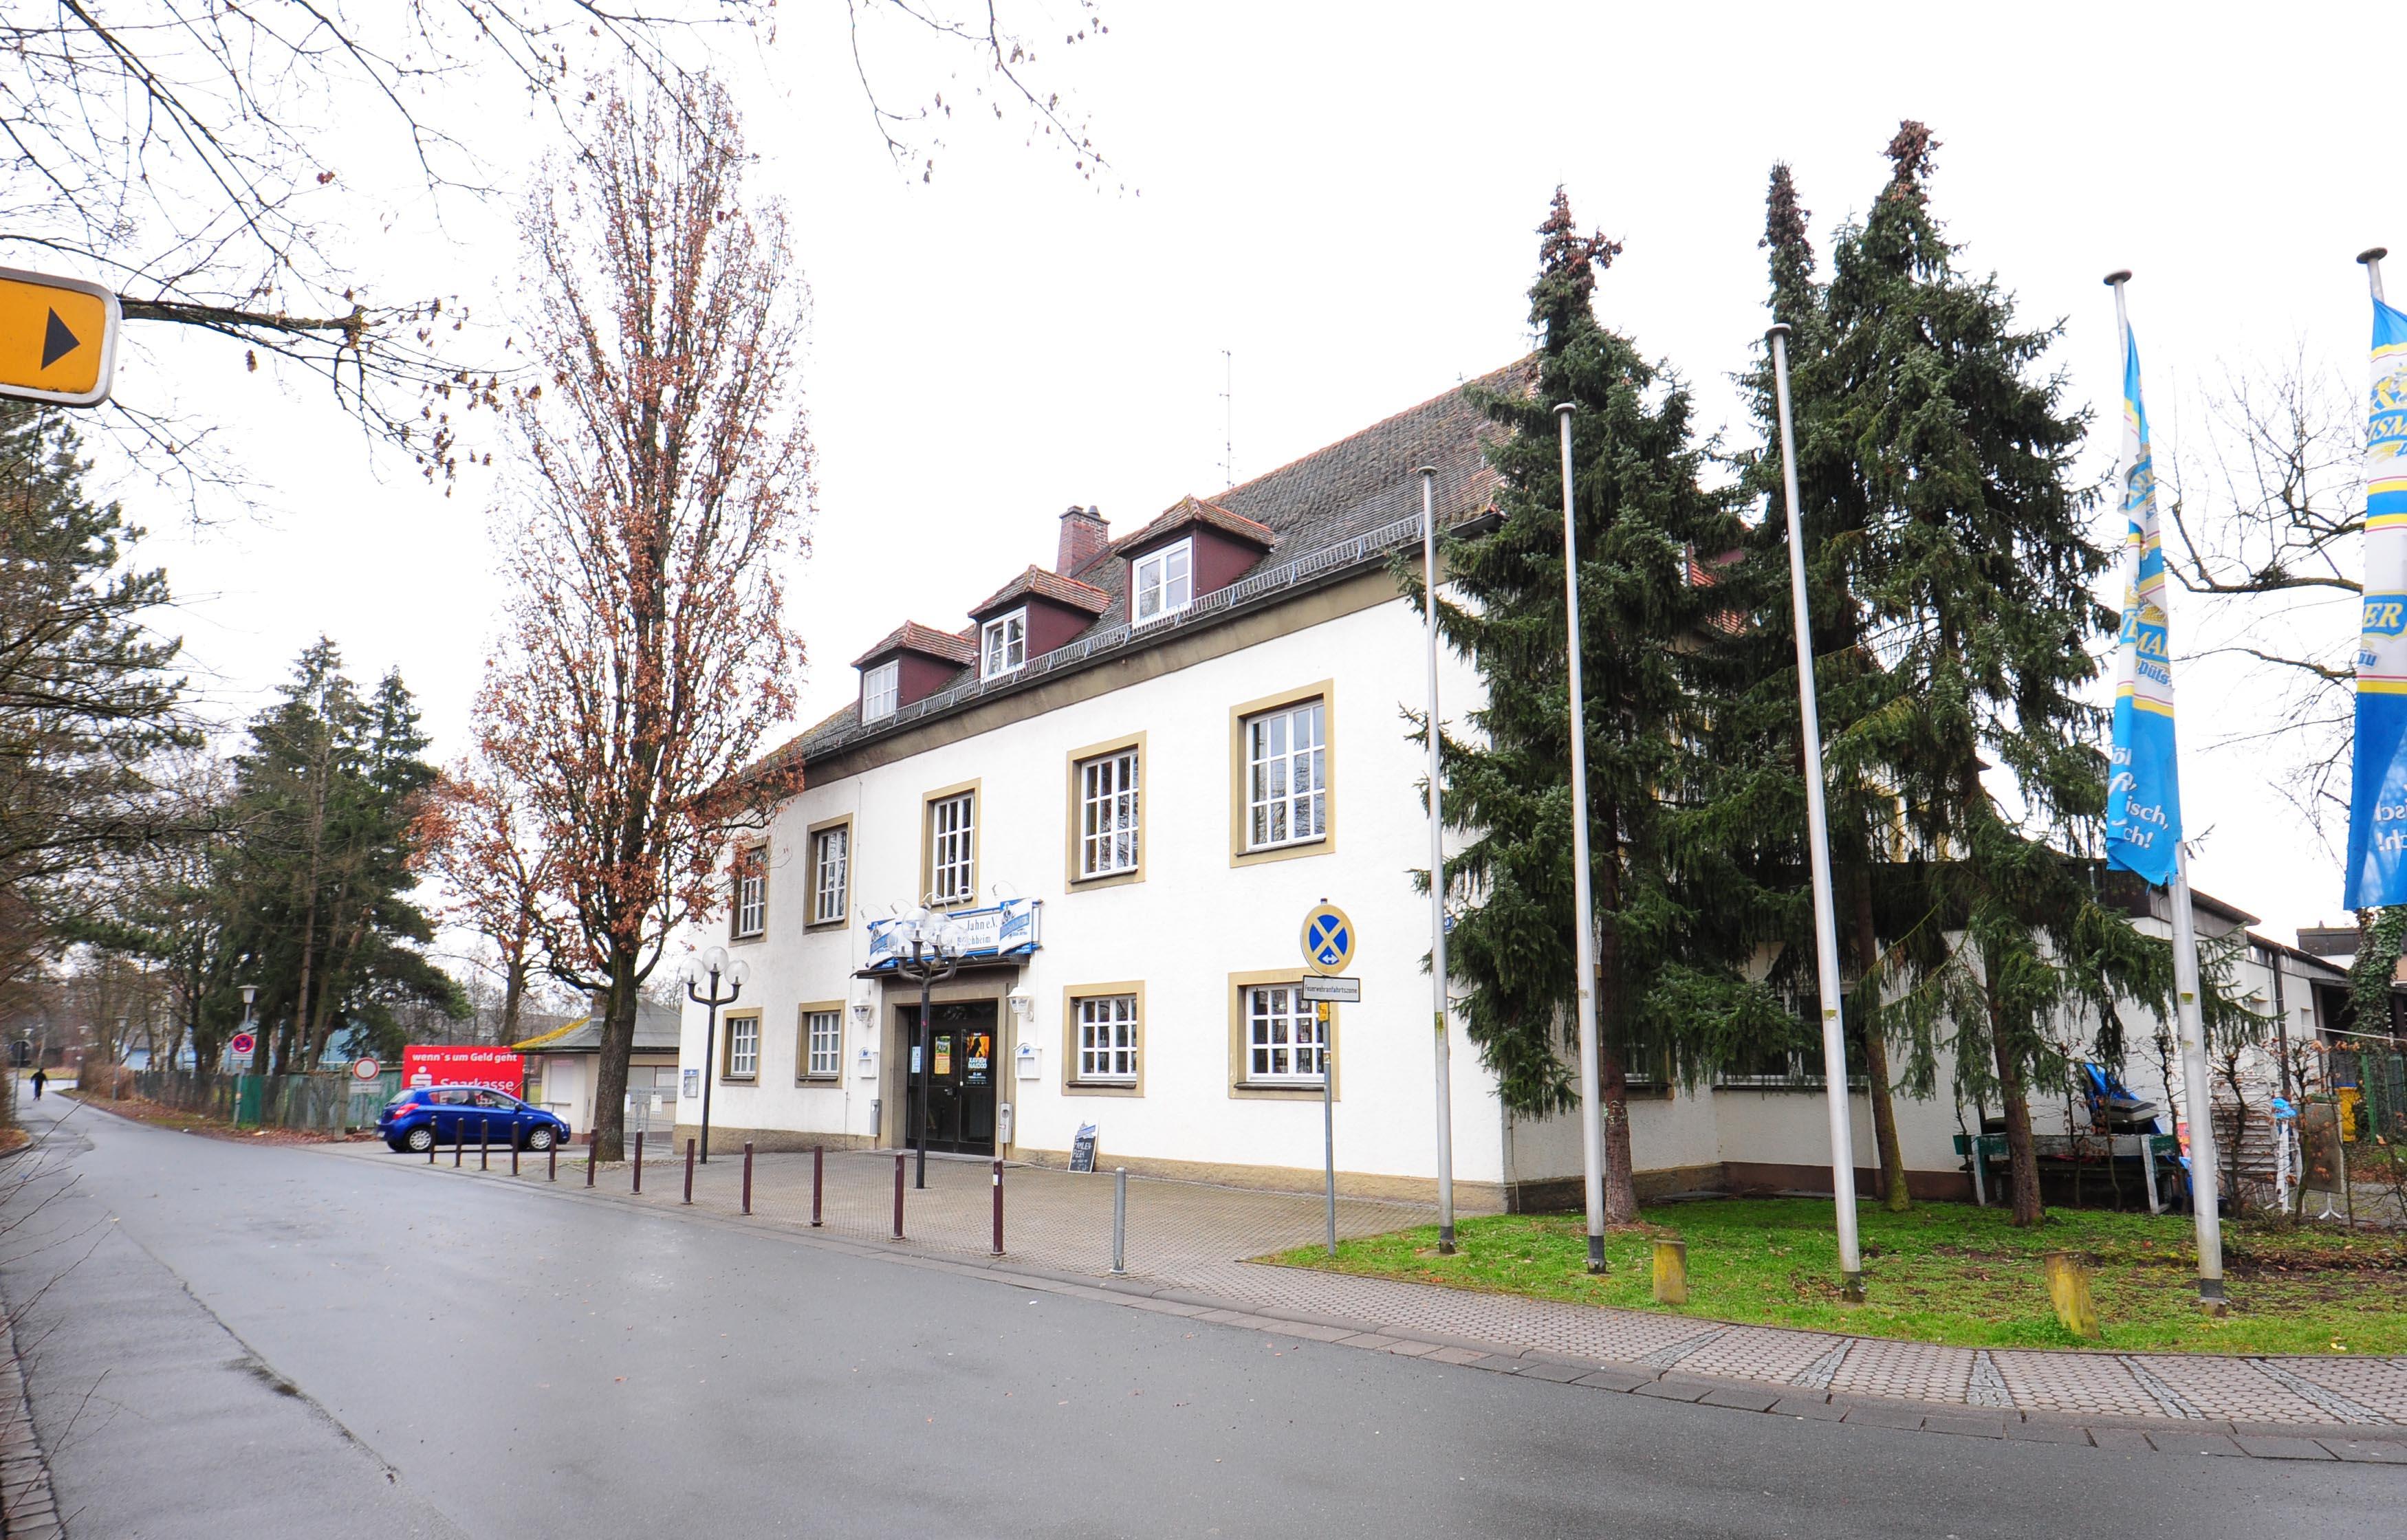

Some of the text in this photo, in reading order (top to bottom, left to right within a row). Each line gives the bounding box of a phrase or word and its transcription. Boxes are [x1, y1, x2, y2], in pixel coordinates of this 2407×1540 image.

[966, 920, 984, 931] Jahn
[470, 1053, 492, 1062] Geld
[494, 1053, 518, 1064] geht
